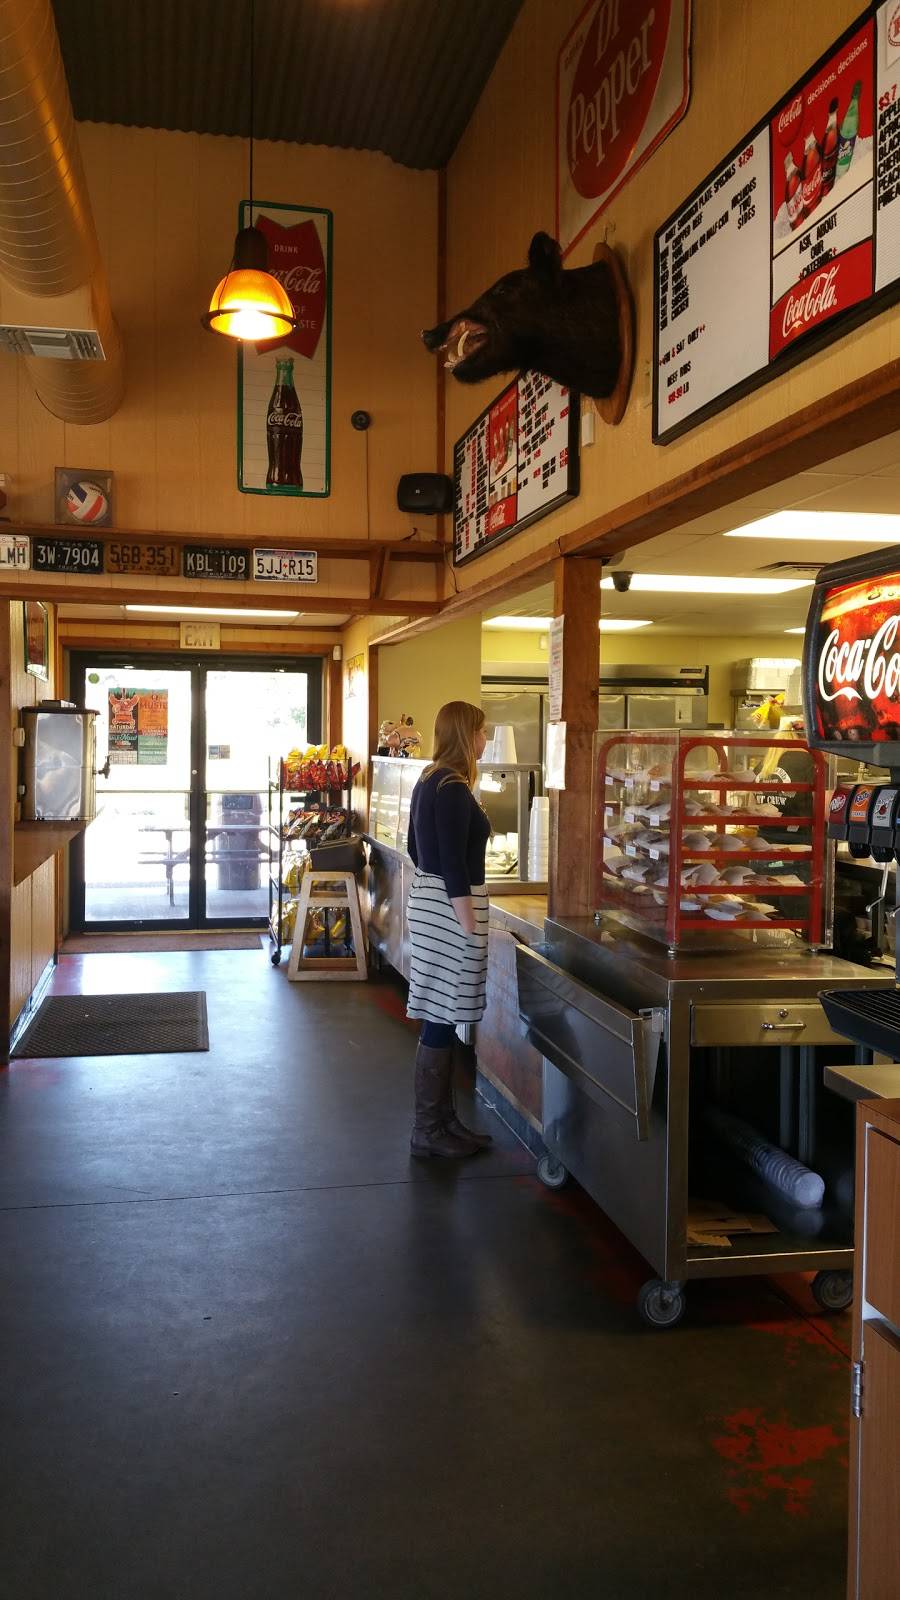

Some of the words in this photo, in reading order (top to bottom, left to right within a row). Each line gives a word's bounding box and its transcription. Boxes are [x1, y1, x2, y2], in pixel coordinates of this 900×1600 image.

[837, 39, 868, 74] decisions
[571, 7, 655, 173] Pepper
[698, 186, 714, 209] PLATE
[713, 163, 736, 193] SPECIALS
[731, 177, 757, 210] INCLUDES
[737, 204, 756, 230] SIDES
[738, 195, 752, 215] TWO
[799, 233, 812, 254] ASK
[816, 212, 837, 240] ABOUT
[274, 243, 298, 254] DRINK
[811, 240, 824, 259] OUR
[268, 266, 322, 294] ca-Cola
[782, 264, 840, 338] Coca-Cola
[297, 319, 317, 329] STE
[268, 412, 301, 427] Coca-Cola
